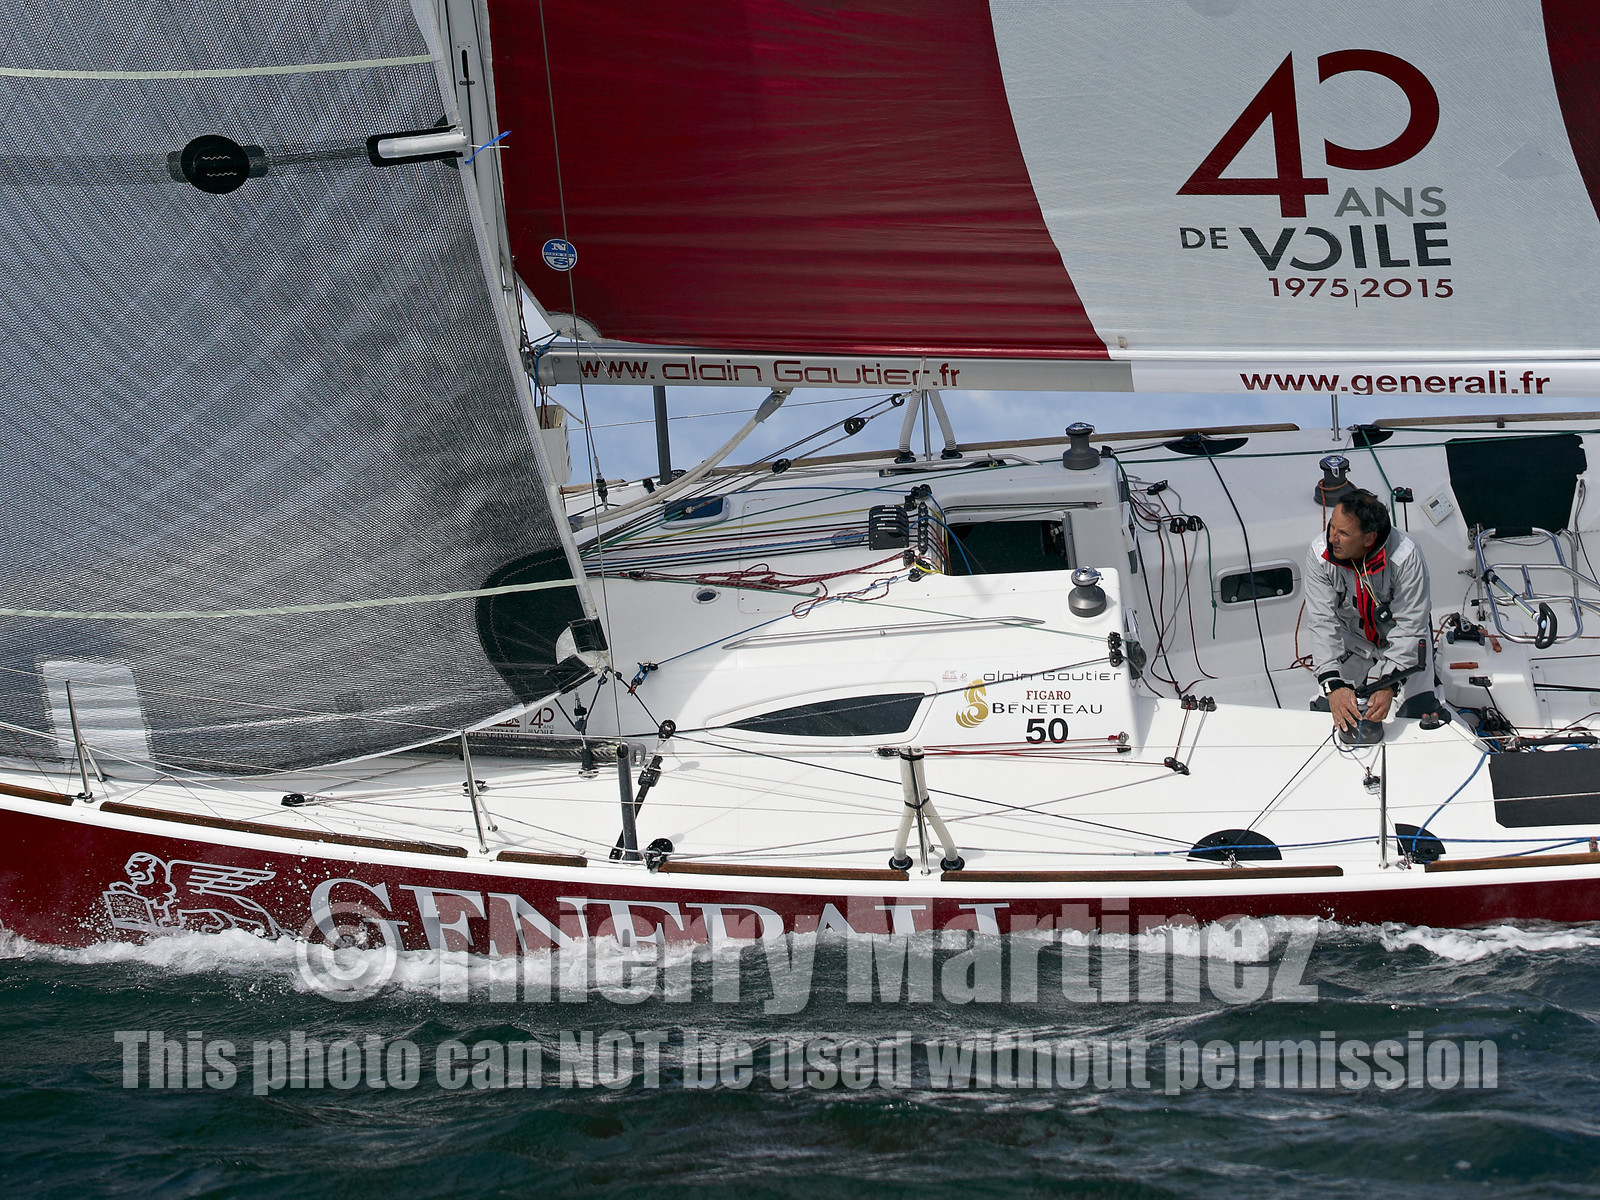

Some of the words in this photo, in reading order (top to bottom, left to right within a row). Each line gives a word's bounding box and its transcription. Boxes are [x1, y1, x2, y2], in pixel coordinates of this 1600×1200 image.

[1176, 49, 1439, 218] 40
[1334, 186, 1446, 217] ANS
[1180, 227, 1228, 249] DE
[1239, 221, 1451, 271] VOILE
[1239, 369, 1551, 395] www.generali.fr
[1026, 690, 1071, 700] FIGARO
[1025, 717, 1069, 744] 50
